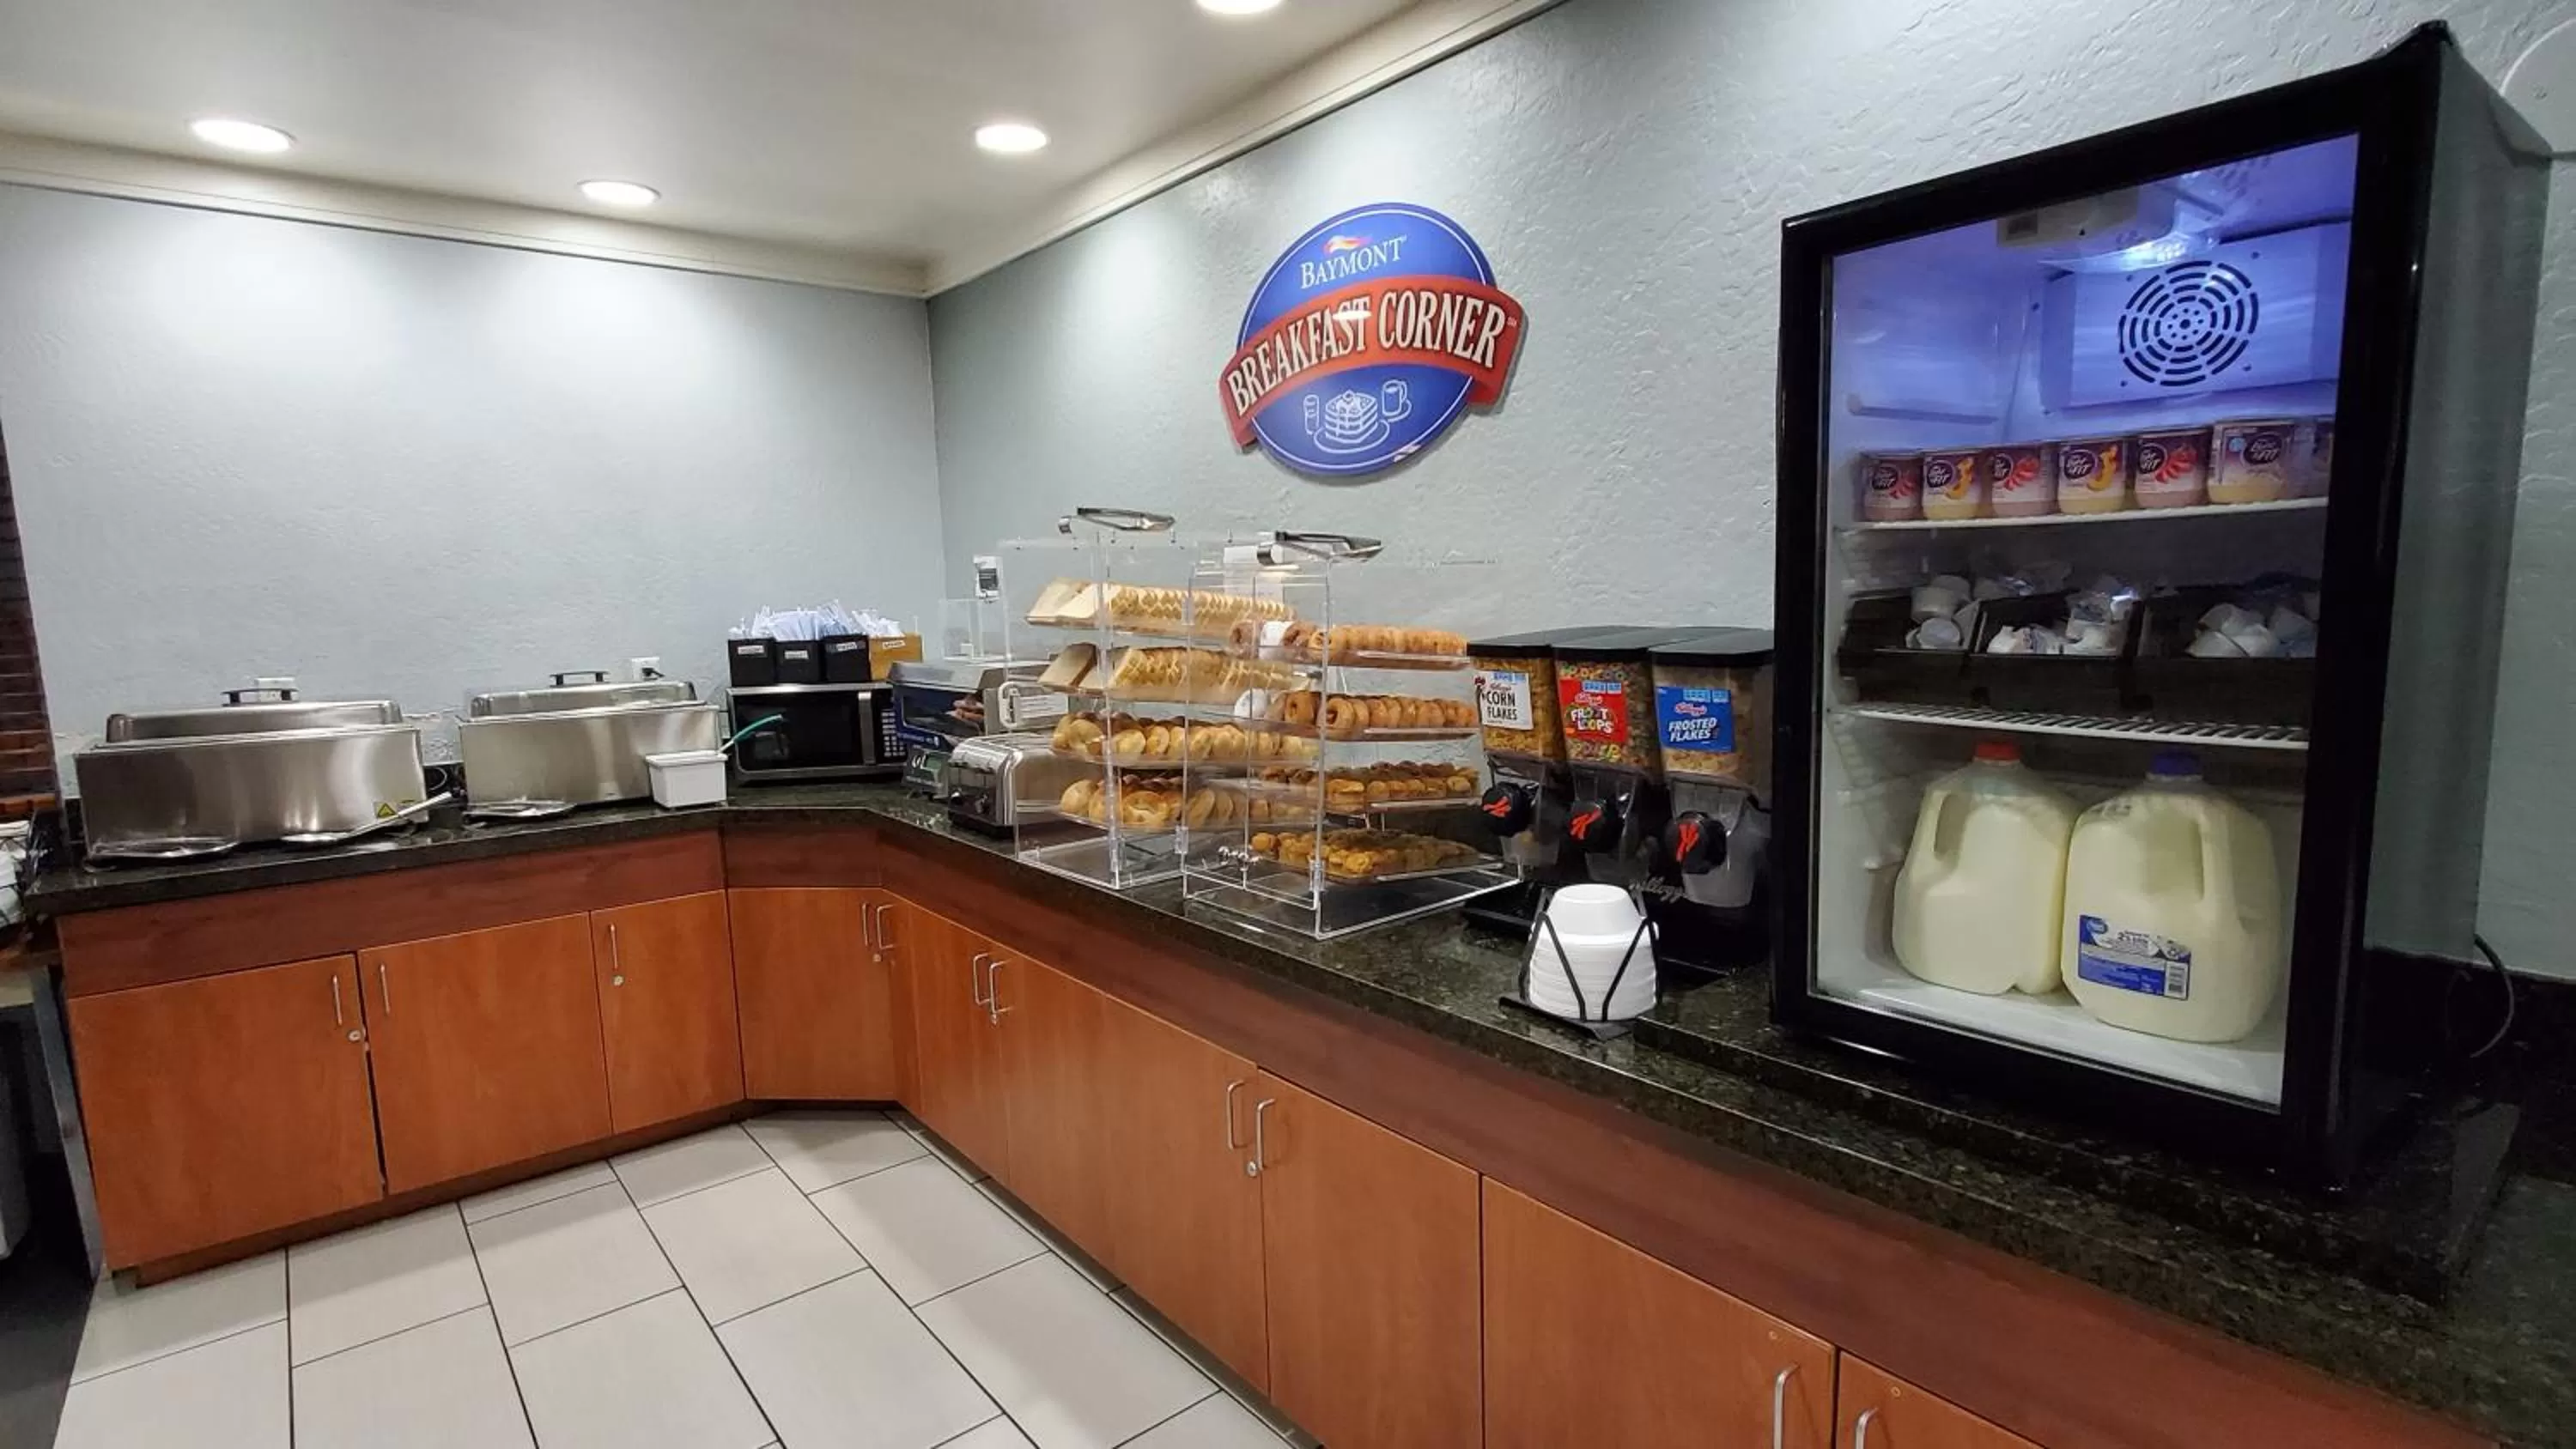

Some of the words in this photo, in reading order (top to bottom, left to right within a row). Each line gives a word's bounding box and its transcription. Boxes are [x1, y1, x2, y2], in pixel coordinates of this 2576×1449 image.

[1300, 237, 1405, 289] BAYMONT
[1227, 296, 1371, 416] BREAKFAST
[1378, 290, 1505, 368] CORNER
[1486, 691, 1516, 706] CORN
[1486, 706, 1517, 720] FLAKES
[1668, 718, 1717, 732] FROSTED
[1670, 730, 1711, 743] FLAKES
